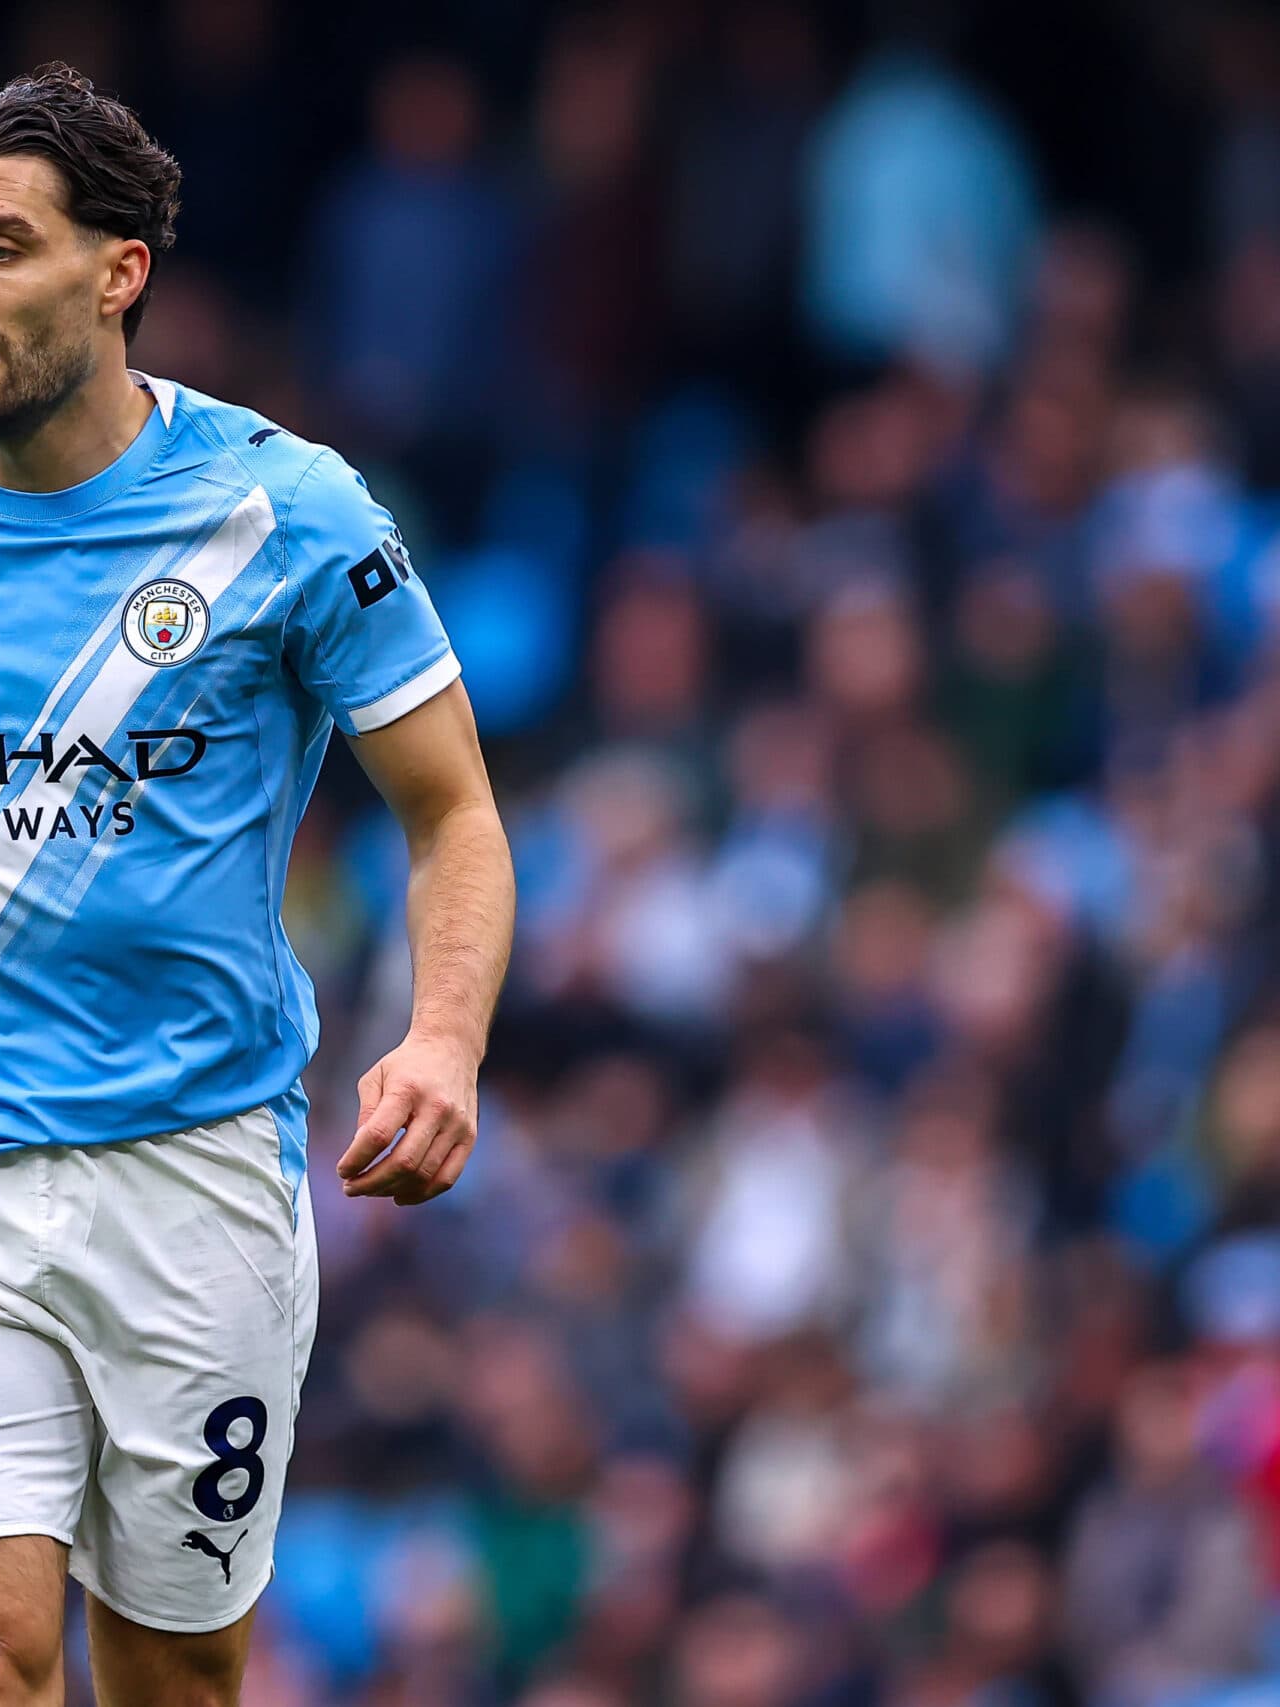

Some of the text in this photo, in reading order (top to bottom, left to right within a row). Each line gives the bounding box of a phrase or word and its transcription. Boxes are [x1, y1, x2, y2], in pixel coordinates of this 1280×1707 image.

[347, 527, 410, 609] OK
[133, 585, 201, 614] MANCHESTER
[150, 651, 176, 661] CITY
[192, 1395, 267, 1523] 8
